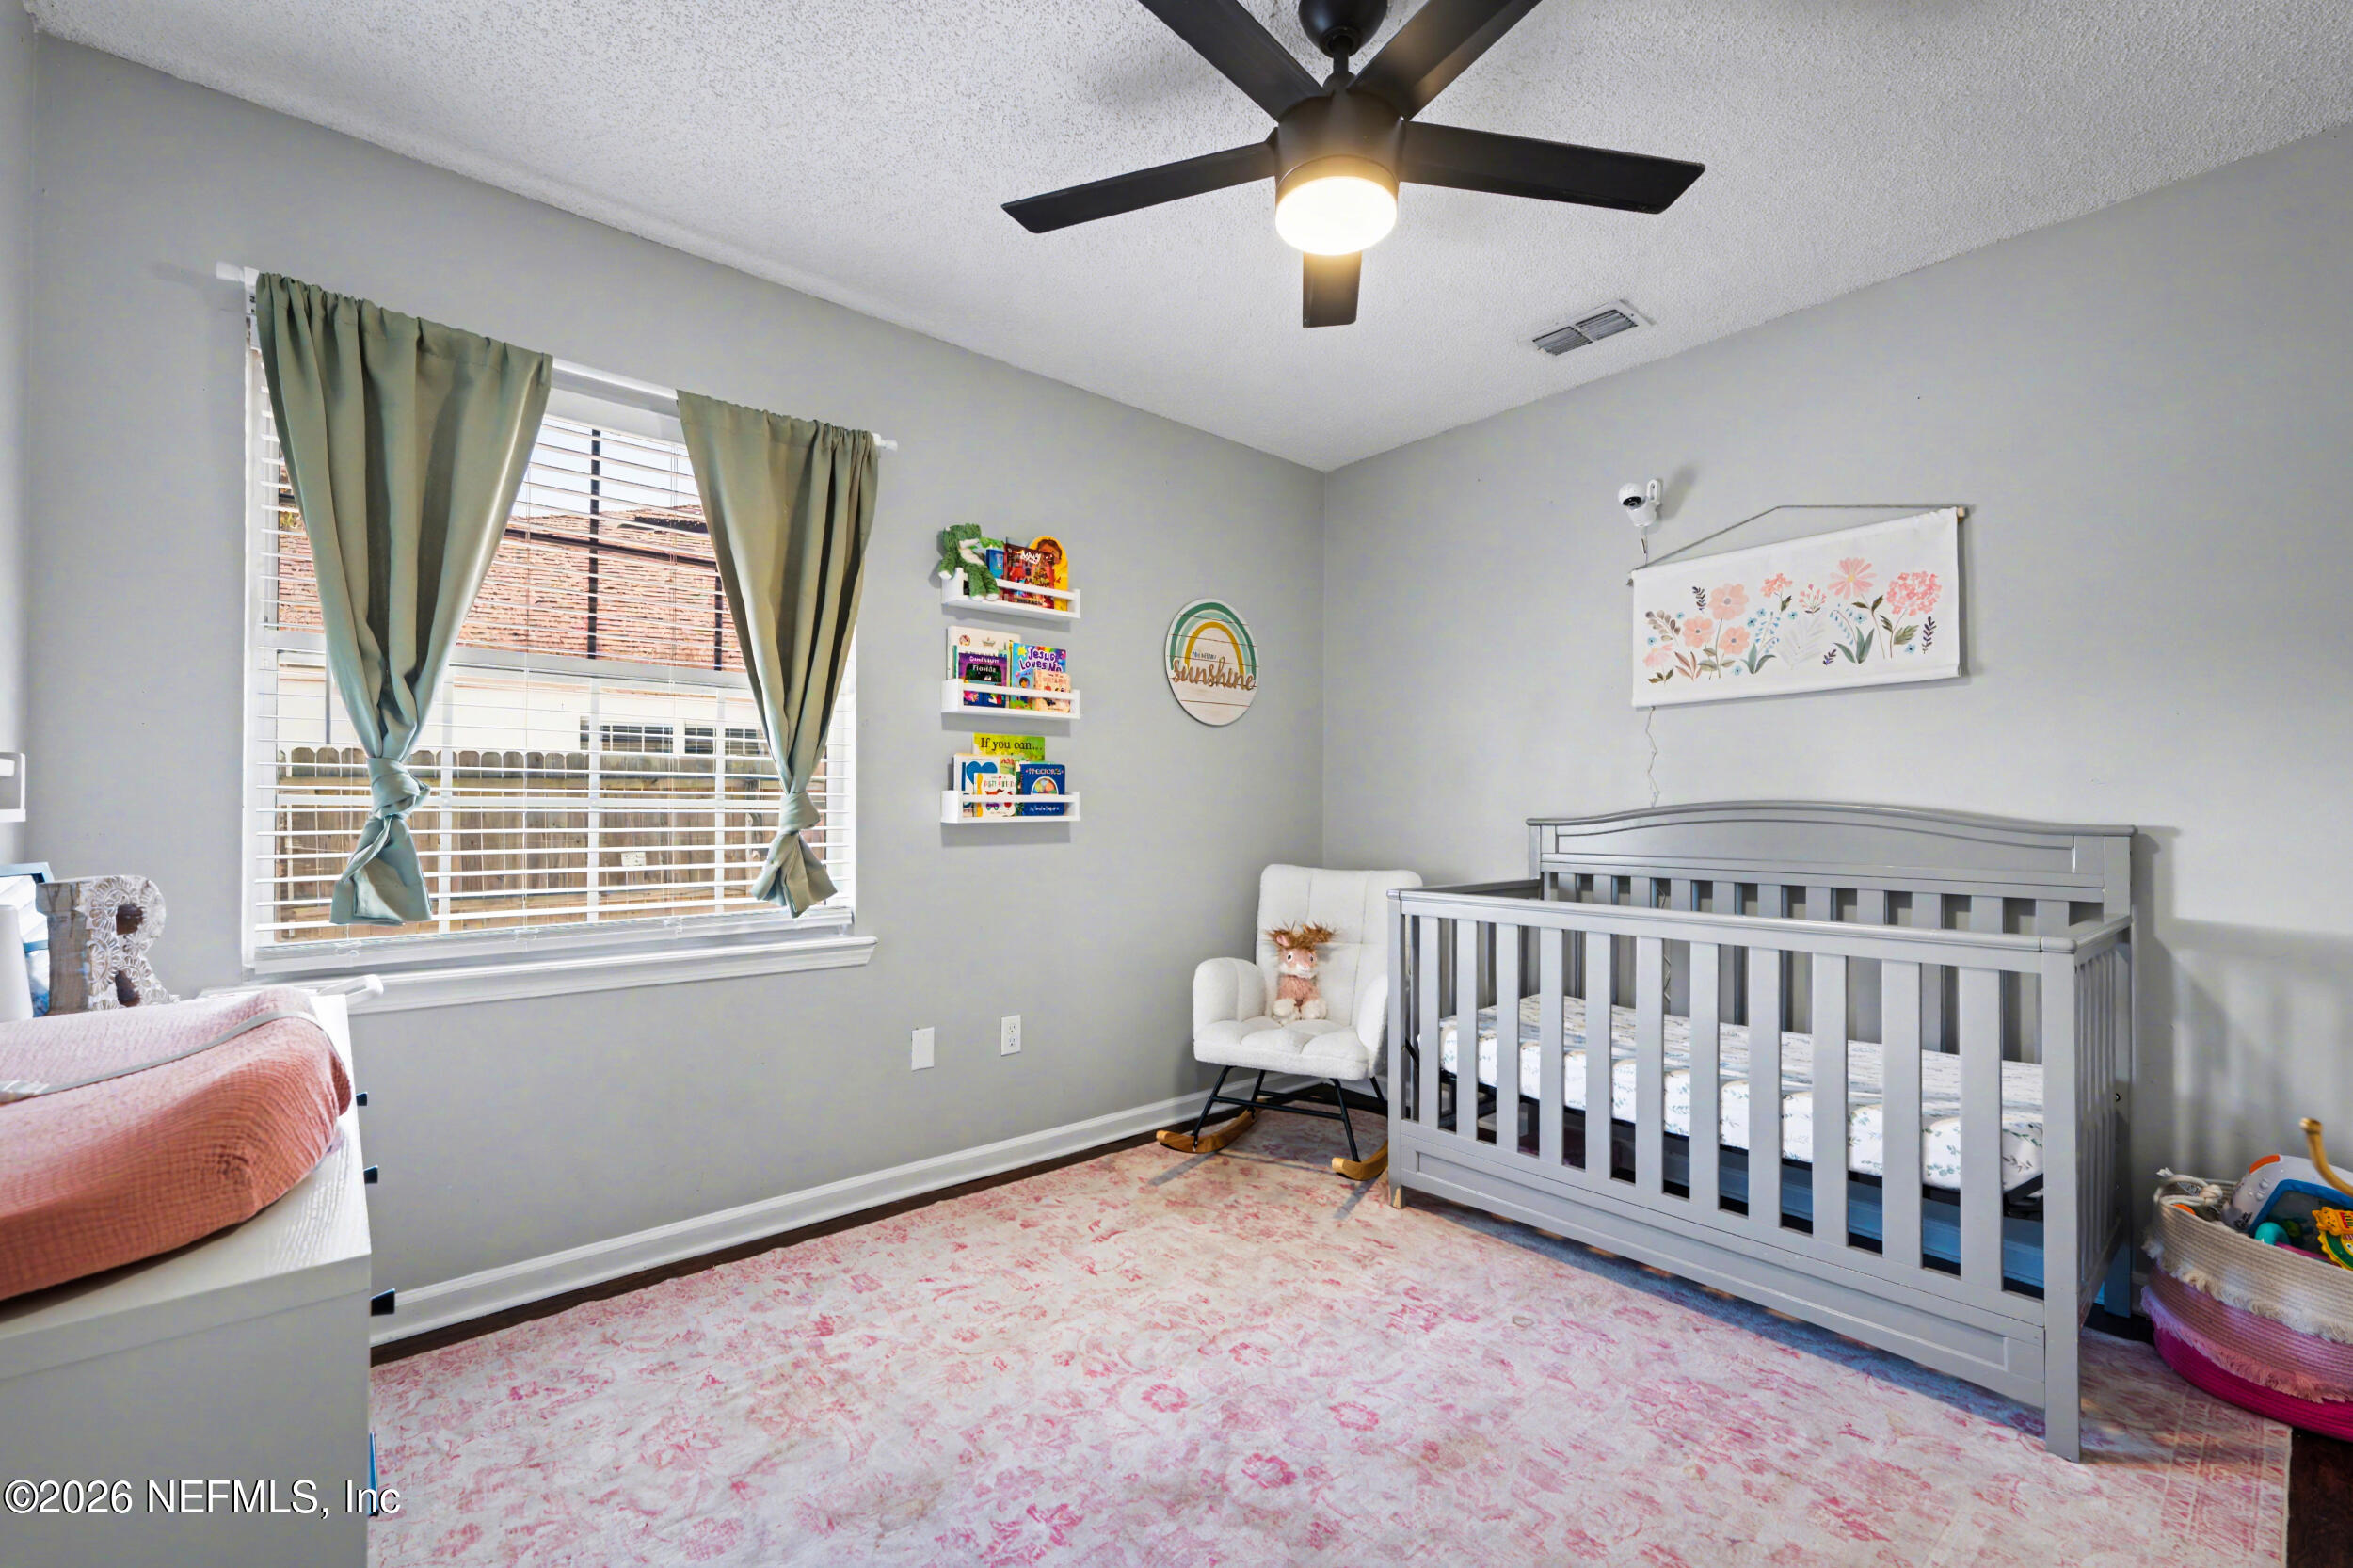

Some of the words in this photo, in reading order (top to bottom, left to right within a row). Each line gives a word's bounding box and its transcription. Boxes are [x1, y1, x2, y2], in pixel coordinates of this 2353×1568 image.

[1019, 658, 1047, 670] Loves
[980, 737, 991, 748] If
[992, 740, 1011, 751] you
